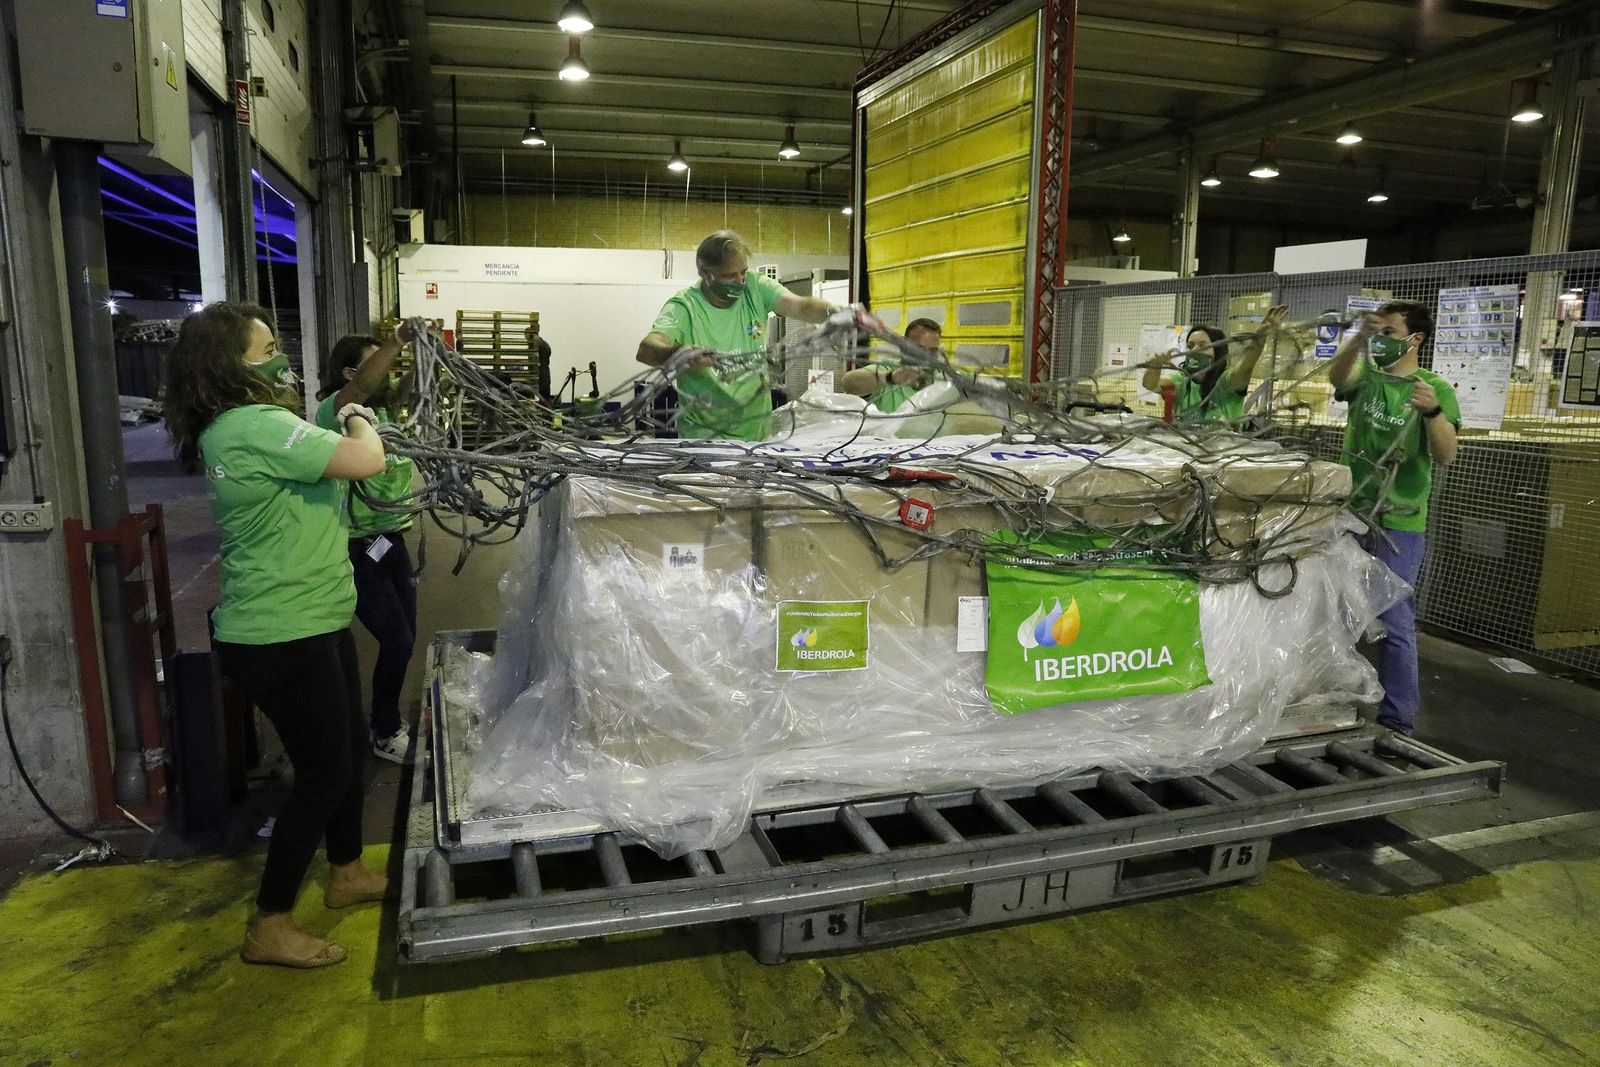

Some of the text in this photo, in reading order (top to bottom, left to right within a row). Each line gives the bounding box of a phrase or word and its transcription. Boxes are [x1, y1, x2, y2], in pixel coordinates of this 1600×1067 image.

[797, 649, 855, 660] IBERDROLA
[1034, 645, 1174, 682] IBERDROLA
[1219, 845, 1253, 870] 15
[800, 912, 848, 941] 15
